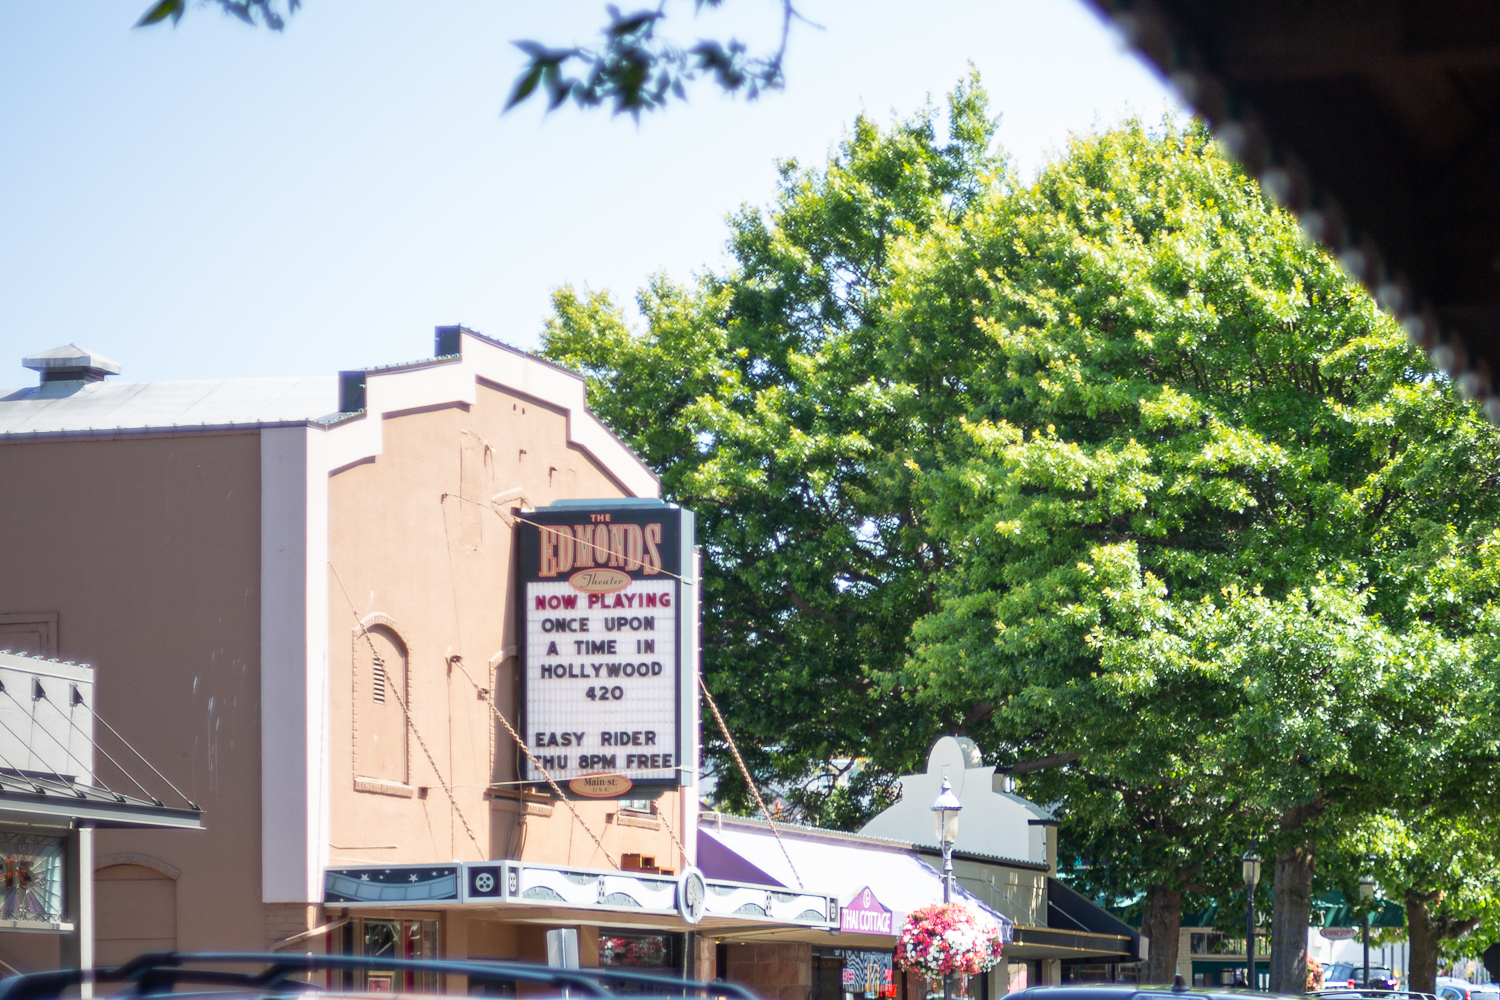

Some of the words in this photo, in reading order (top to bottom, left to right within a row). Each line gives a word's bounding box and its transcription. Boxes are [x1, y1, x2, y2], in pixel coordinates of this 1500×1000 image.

[590, 513, 611, 522] THE
[538, 522, 662, 578] EDMONDS
[579, 573, 624, 588] Theater
[535, 594, 578, 610] NOW
[587, 592, 671, 610] PLAYING
[541, 617, 590, 633] ONCE
[604, 615, 655, 631] UPON
[546, 641, 560, 656] A
[574, 639, 617, 655] TIME
[636, 639, 655, 654] IN
[540, 661, 663, 679] HOLLYWOOD
[585, 686, 624, 701] 420
[535, 731, 586, 748] EASY
[600, 730, 657, 747] RIDER
[533, 754, 568, 770] THU
[578, 754, 616, 769] 8PM
[626, 753, 673, 769] FREE
[584, 778, 605, 786] Main
[842, 909, 859, 931] THAI
[860, 909, 891, 933] COTTAGE
